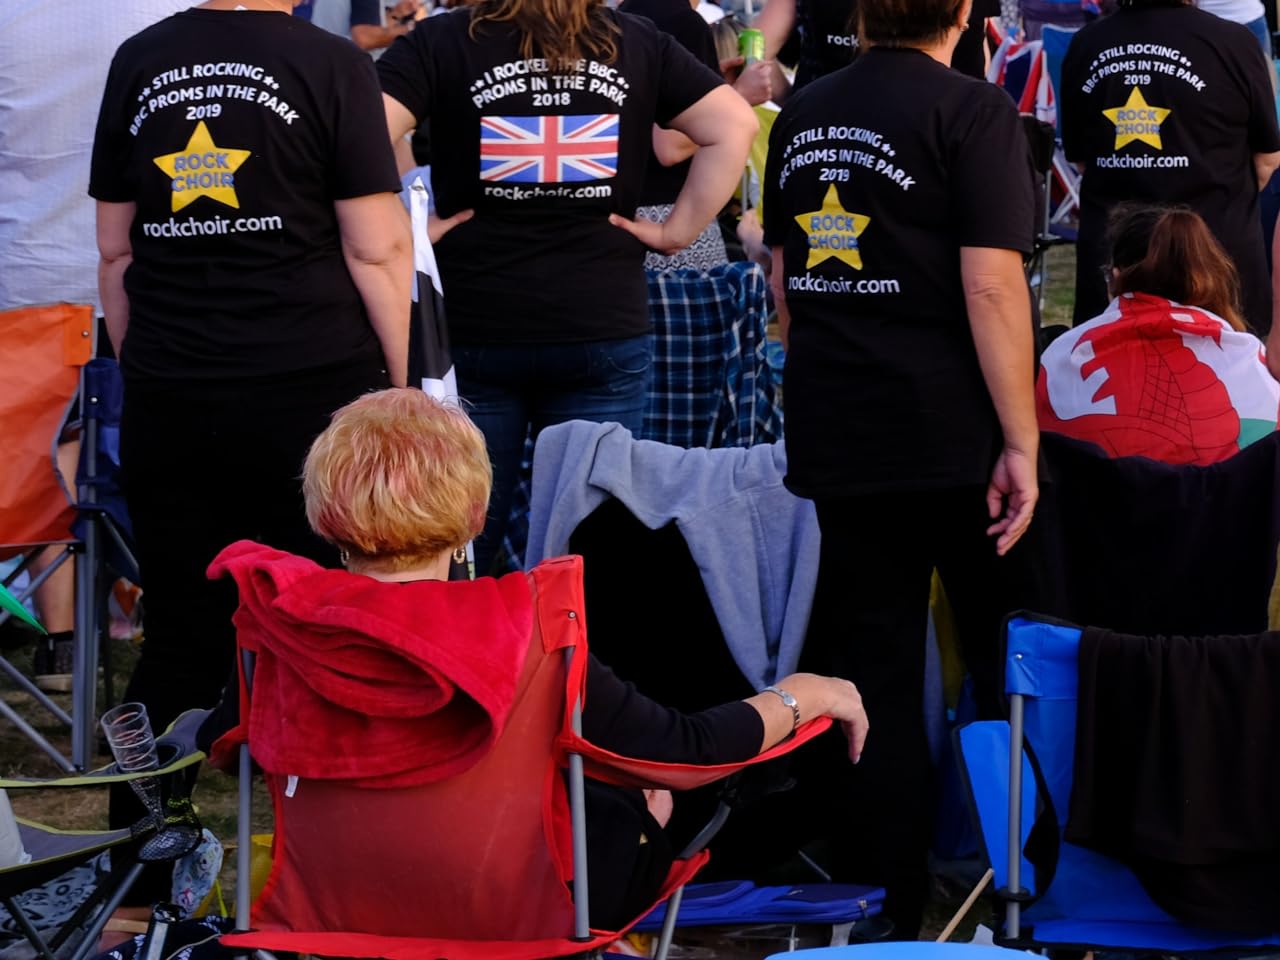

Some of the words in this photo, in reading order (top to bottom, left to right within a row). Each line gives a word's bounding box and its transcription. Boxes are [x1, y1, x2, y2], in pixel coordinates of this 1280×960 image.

[1098, 45, 1126, 63] STILL
[1126, 43, 1181, 61] ROCKING
[151, 66, 191, 91] STILL
[192, 62, 265, 82] ROCKING
[484, 71, 493, 85] I
[588, 60, 618, 82] BBC
[1081, 73, 1100, 94] BBC
[1098, 60, 1136, 79] PROMS
[1137, 60, 1151, 71] IN
[1152, 61, 1176, 76] THE
[1176, 67, 1207, 92] PARK
[1123, 74, 1152, 86] 2019
[471, 77, 528, 110] PROMS
[531, 76, 548, 92] IN
[552, 75, 586, 90] THE
[588, 78, 628, 107] PARK
[532, 92, 571, 107] 2018
[129, 106, 149, 137] BBC
[149, 86, 204, 113] PROMS
[205, 84, 224, 99] IN
[226, 84, 258, 102] THE
[256, 91, 300, 126] PARK
[185, 103, 222, 121] 2019
[1116, 109, 1157, 122] ROCK
[793, 126, 825, 149] STILL
[827, 126, 883, 148] ROCKING
[1115, 123, 1161, 135] CHOIR
[174, 152, 229, 173] ROCK
[790, 148, 838, 171] PROMS
[839, 149, 851, 163] IN
[851, 150, 875, 168] THE
[874, 159, 917, 191] PARK
[1096, 153, 1190, 169] rockchoir.com
[171, 173, 235, 193] CHOIR
[818, 167, 851, 182] 2019
[143, 215, 282, 238] rockchoir.com
[810, 214, 856, 232] ROCK
[807, 235, 860, 251] CHOIR
[788, 271, 901, 294] rockchoir.com
